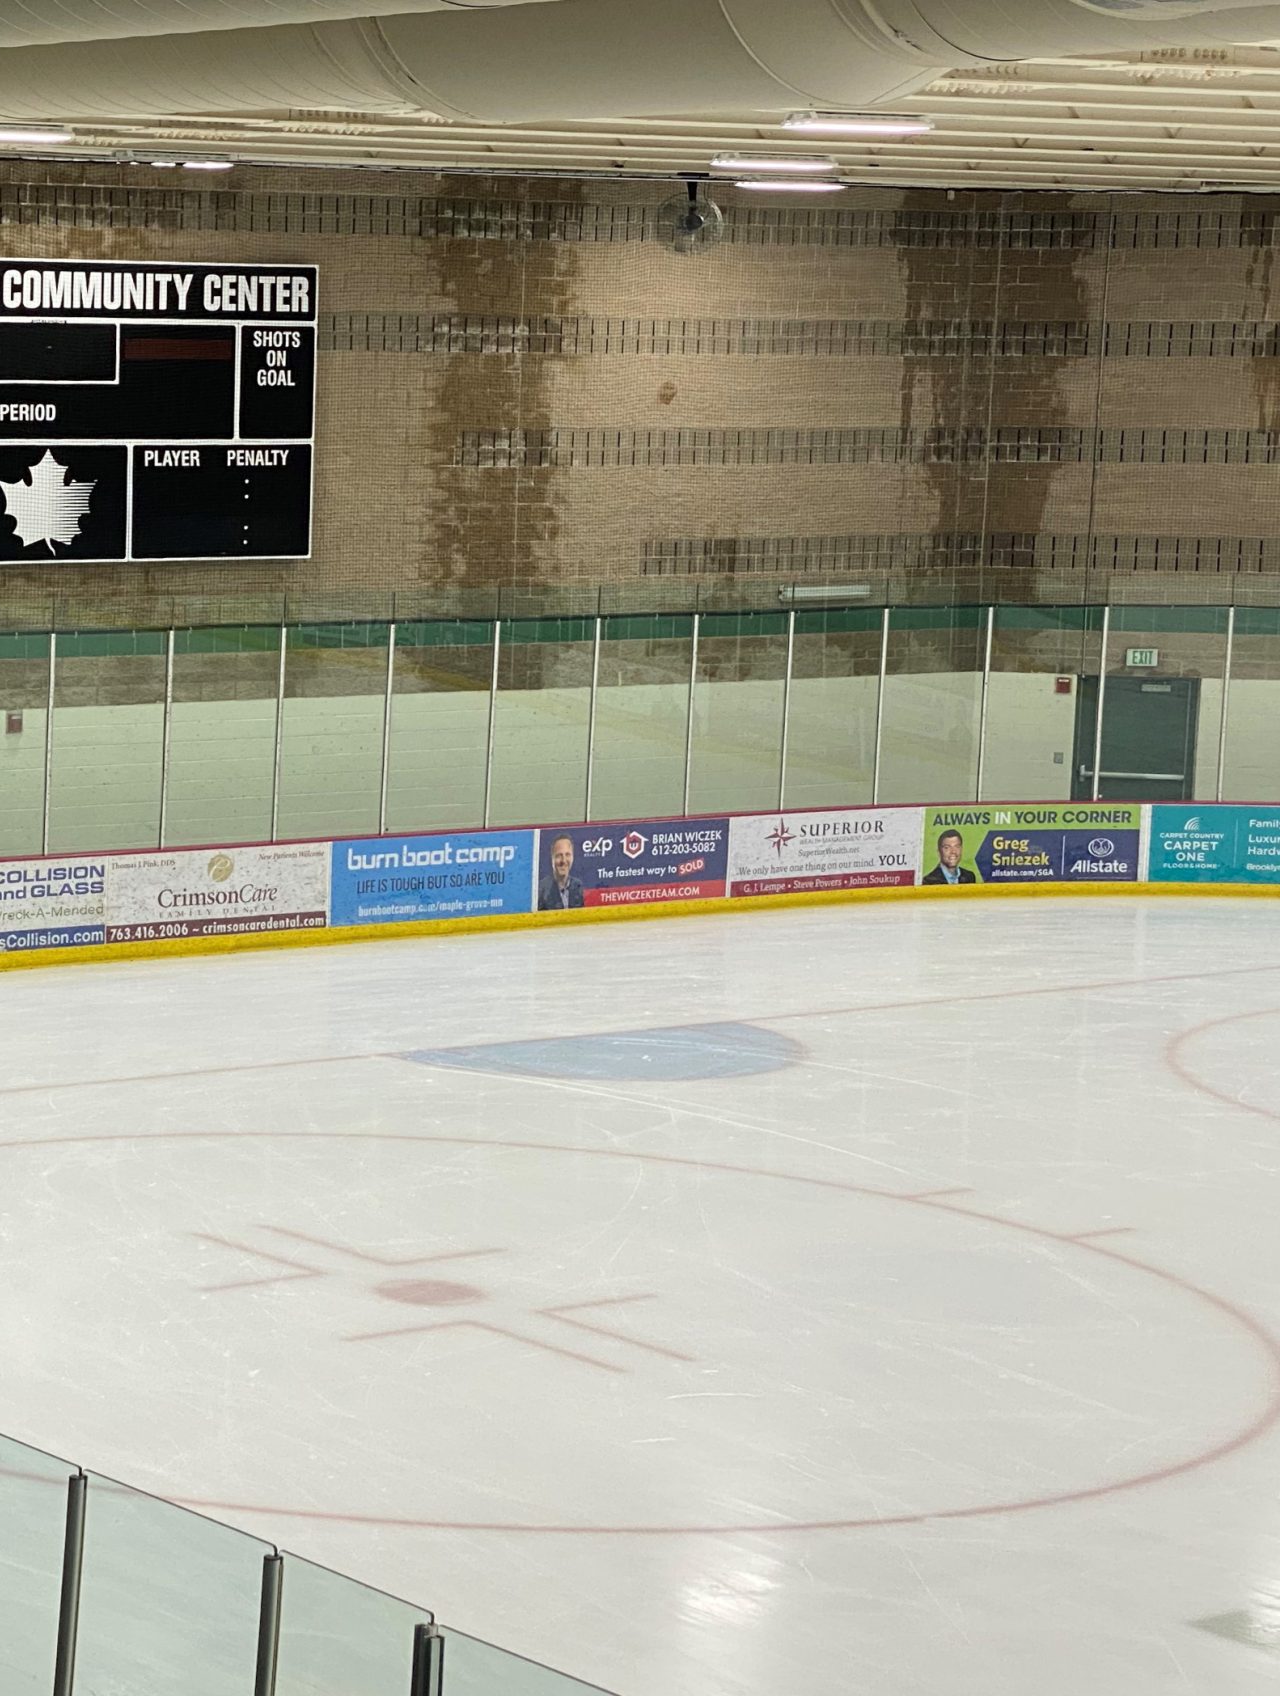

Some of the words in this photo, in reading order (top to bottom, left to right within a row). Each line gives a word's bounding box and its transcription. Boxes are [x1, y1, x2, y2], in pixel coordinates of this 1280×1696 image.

[2, 269, 194, 312] COMMUNITY
[203, 273, 310, 314] CENTER
[253, 330, 301, 349] SHOTS
[266, 350, 288, 368] ON
[256, 369, 296, 388] GOAL
[143, 449, 201, 469] PLAYER
[226, 448, 290, 468] PENALTY
[1132, 651, 1154, 665] EXIT
[933, 811, 991, 826] ALWAYS
[995, 811, 1011, 824] IN
[1014, 810, 1058, 824] YOUR
[1062, 810, 1131, 824] CORNER
[652, 832, 682, 845] BRIAN
[685, 830, 722, 842] WICZEK
[800, 820, 885, 838] SUPERIOR
[652, 842, 716, 857] 612-203-5082
[992, 836, 1029, 852] Greg
[1164, 841, 1219, 851] CARPET
[347, 847, 399, 871] burn
[402, 842, 452, 867] boot
[456, 845, 516, 868] camp
[992, 852, 1050, 866] Sniezek
[1175, 851, 1205, 861] ONE
[598, 868, 614, 878] The
[616, 866, 645, 877] fastest
[647, 867, 666, 877] way
[668, 865, 677, 873] to
[680, 860, 704, 874] SOLD
[752, 865, 768, 877] only
[770, 864, 788, 875] have
[789, 864, 803, 873] one
[805, 862, 826, 873] thing
[827, 861, 838, 870] on
[838, 861, 851, 869] our
[879, 854, 907, 866] YOU.
[991, 868, 1054, 878] allstate.com/SGA
[1070, 860, 1128, 873] Allstate
[31, 881, 105, 898] GLASS
[357, 879, 376, 894] LIFE
[378, 878, 388, 892] IS
[390, 876, 424, 892] TOUGH
[427, 875, 448, 890] BUT
[450, 874, 462, 888] SO
[465, 872, 483, 887] ARE
[485, 871, 505, 885] YOU
[743, 884, 752, 893] G.
[760, 882, 785, 893] Lempe
[793, 880, 814, 889] Steve
[815, 878, 842, 888] Powers
[849, 876, 868, 886] John
[869, 873, 900, 885] Soukup
[158, 883, 278, 909] CrimsonCare
[600, 886, 700, 902] THEWICZEKTEAM.COM
[159, 908, 212, 919] FAMILY
[110, 923, 188, 942] 763.416.2006
[202, 914, 325, 935] crimsoncaredental.com
